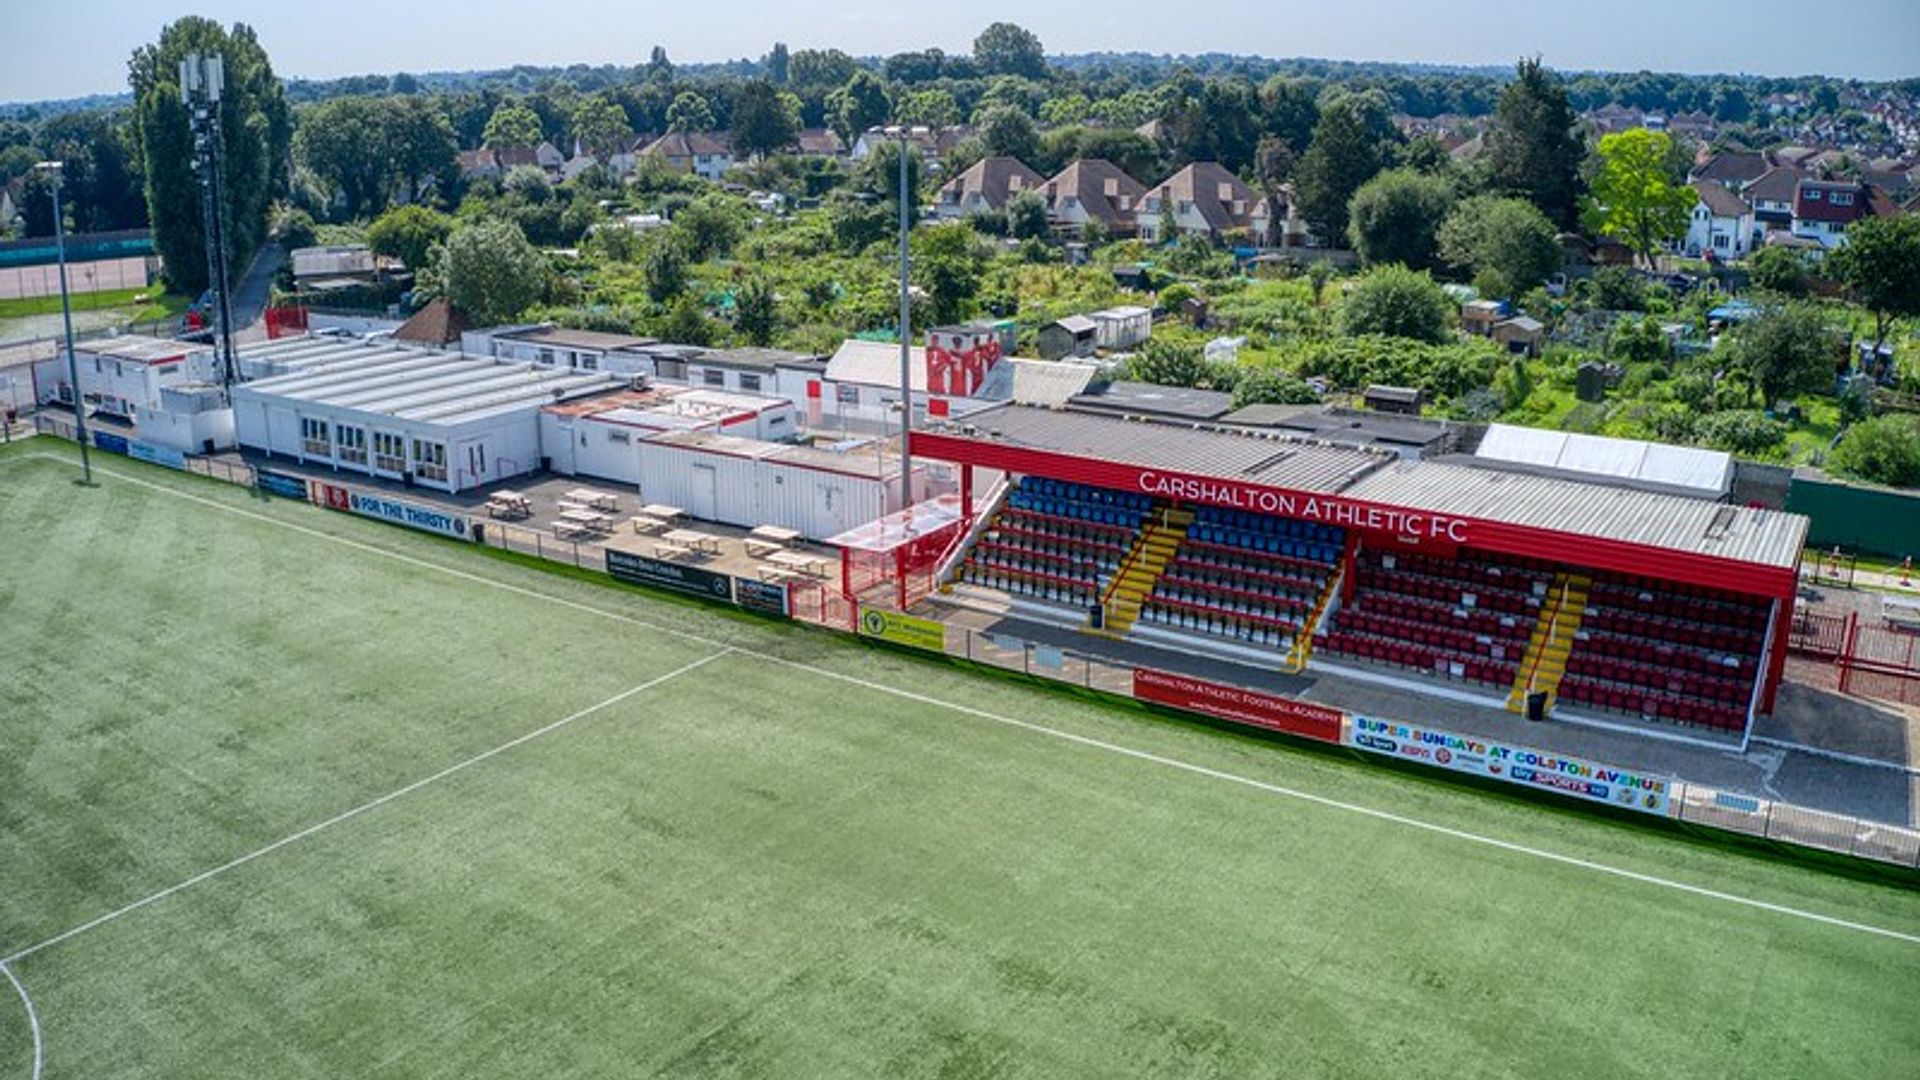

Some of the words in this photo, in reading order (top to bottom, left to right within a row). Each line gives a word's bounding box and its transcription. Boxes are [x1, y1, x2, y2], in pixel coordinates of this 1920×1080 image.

[361, 496, 381, 514] FOR
[382, 501, 404, 519] THE
[405, 506, 451, 531] THIRSTY
[1139, 471, 1295, 514] CARSHALTON
[1302, 498, 1423, 535] ATHLETIC
[1430, 518, 1468, 542] FC
[1135, 670, 1194, 693] CARSHALTON
[1193, 684, 1240, 703] ATHLETIC
[1242, 693, 1291, 713] FOOTBALL
[1293, 705, 1339, 722] ACADEMY
[1357, 717, 1410, 739] SUPER
[1412, 730, 1486, 755] SUNDAYS
[1488, 746, 1511, 760] AT
[1514, 751, 1592, 778] COLSTON
[1595, 767, 1665, 794] AVENUE
